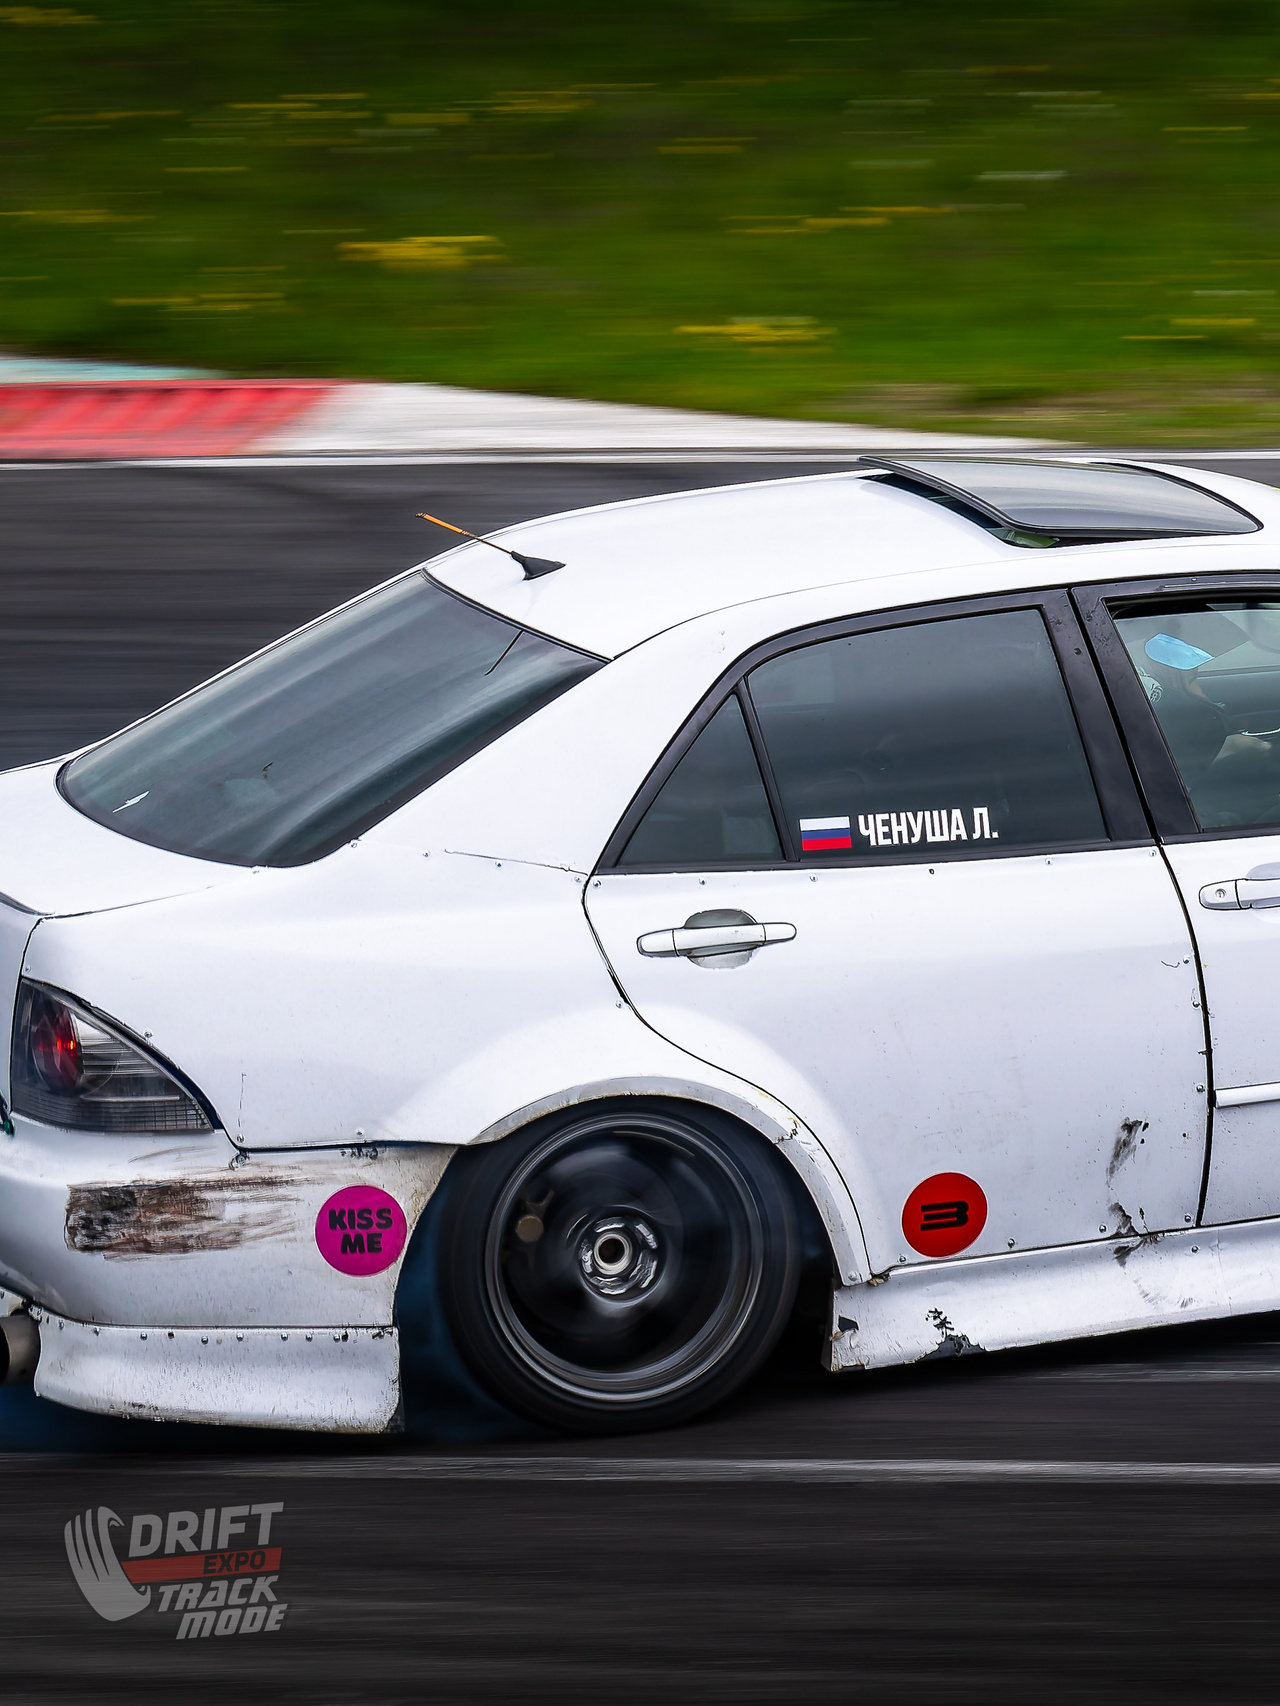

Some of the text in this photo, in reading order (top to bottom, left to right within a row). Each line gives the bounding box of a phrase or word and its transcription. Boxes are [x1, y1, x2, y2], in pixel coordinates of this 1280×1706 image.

[858, 806, 999, 846] ЧЕНУША Л.
[328, 1208, 393, 1231] KISS
[340, 1232, 383, 1255] ME
